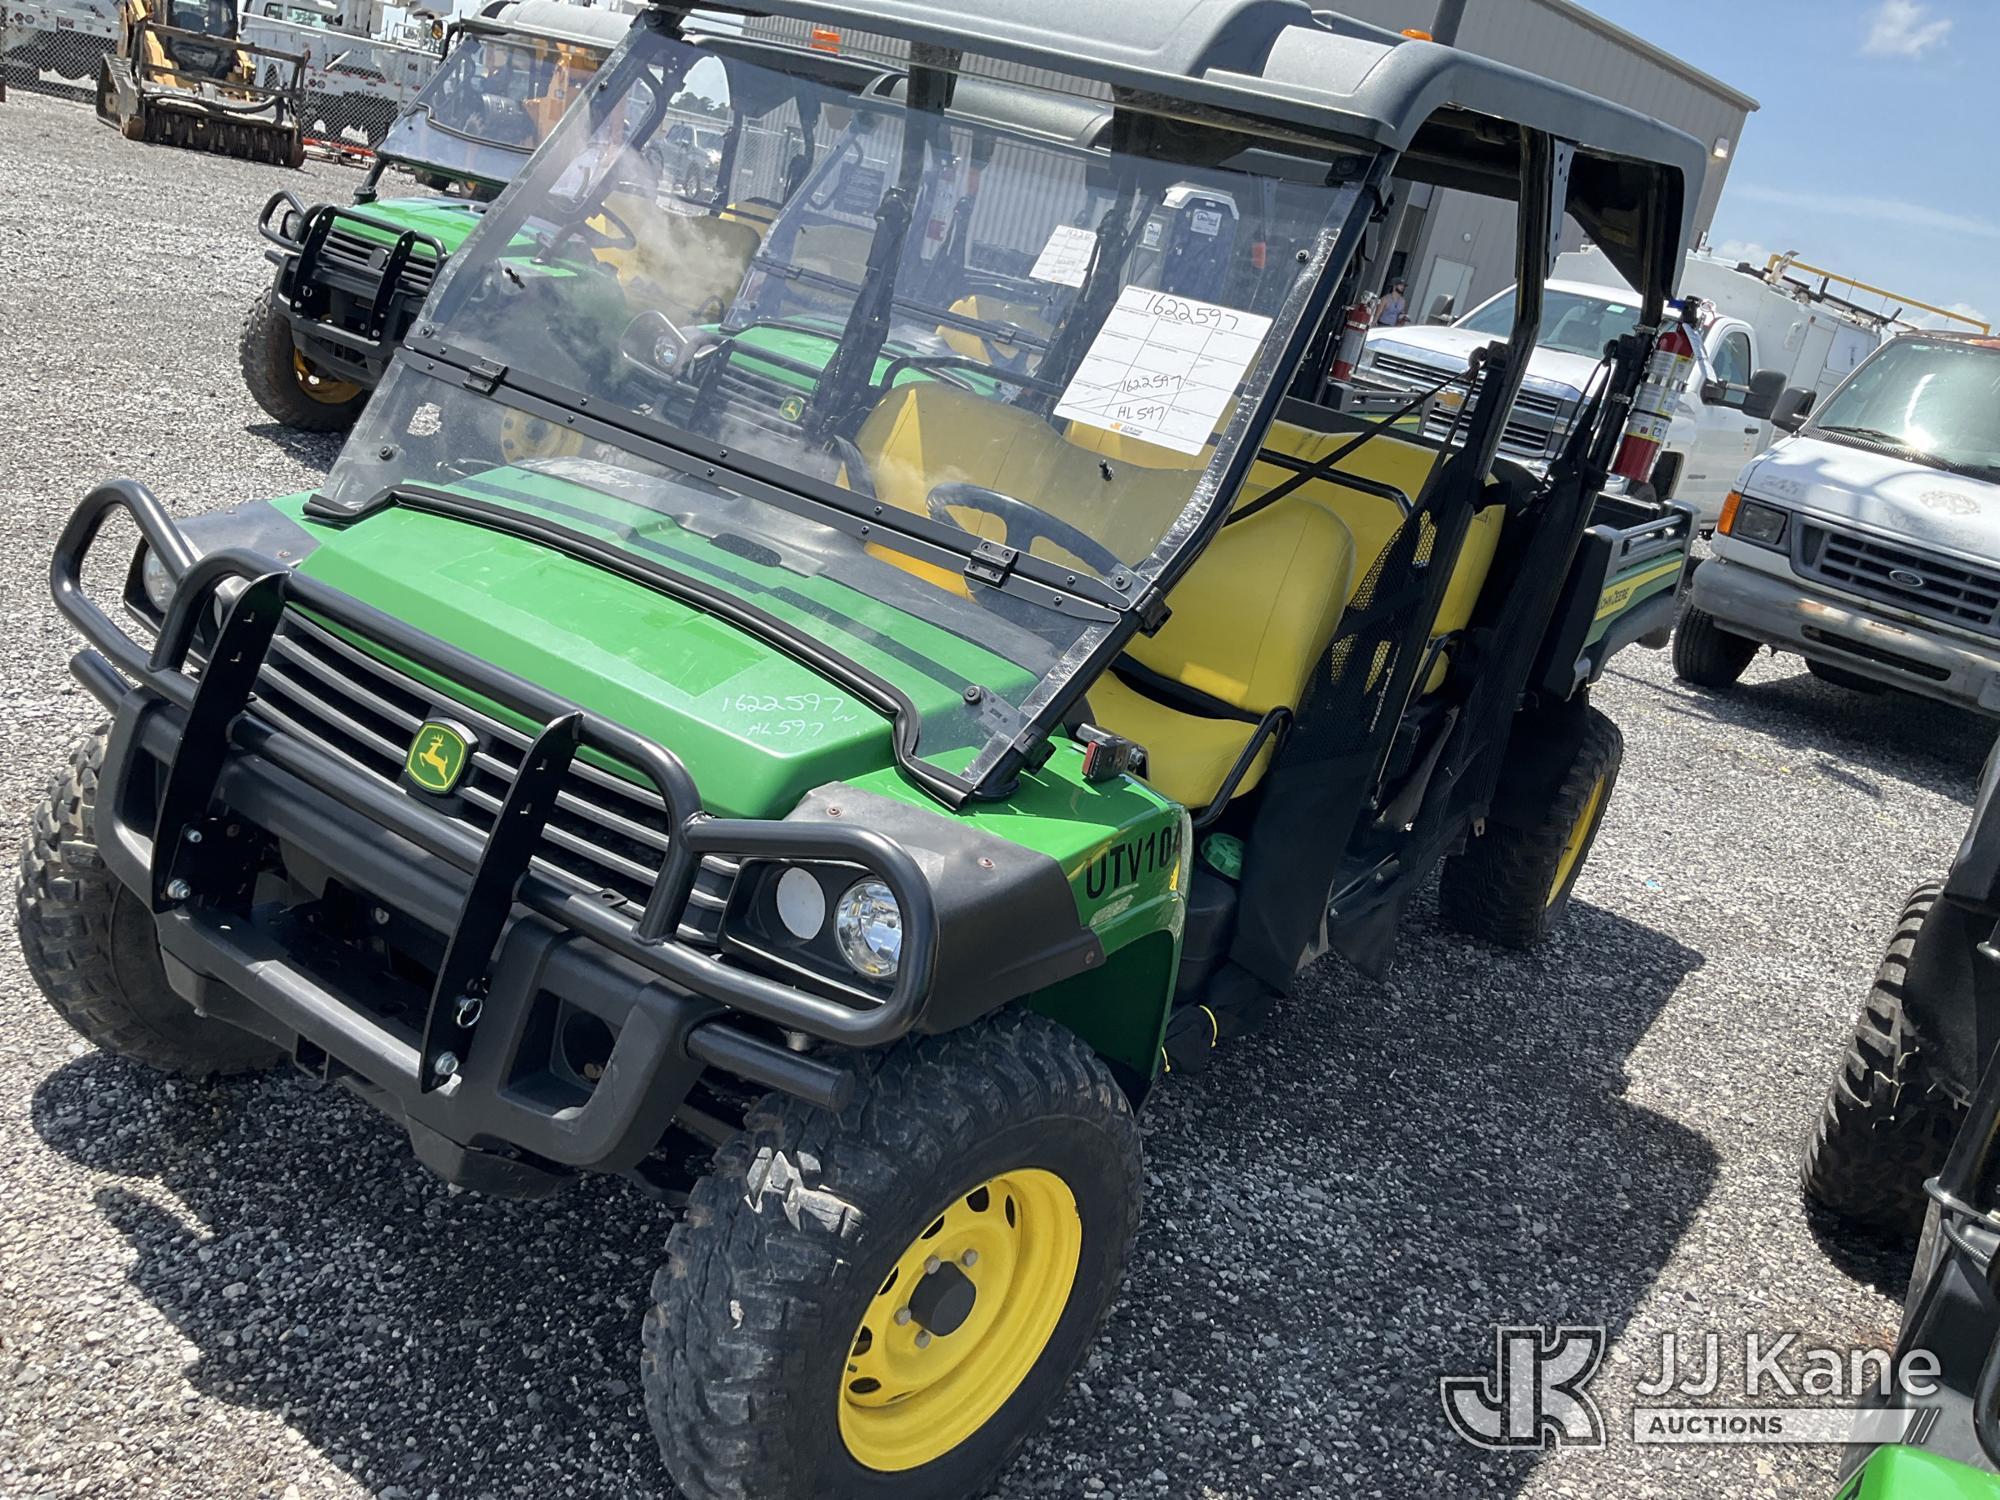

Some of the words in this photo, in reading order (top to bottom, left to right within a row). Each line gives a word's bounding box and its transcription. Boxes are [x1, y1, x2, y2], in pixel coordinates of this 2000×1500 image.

[1145, 294, 1239, 331] 1622597
[1122, 375, 1182, 393] 1622597
[721, 693, 844, 714] 1622597
